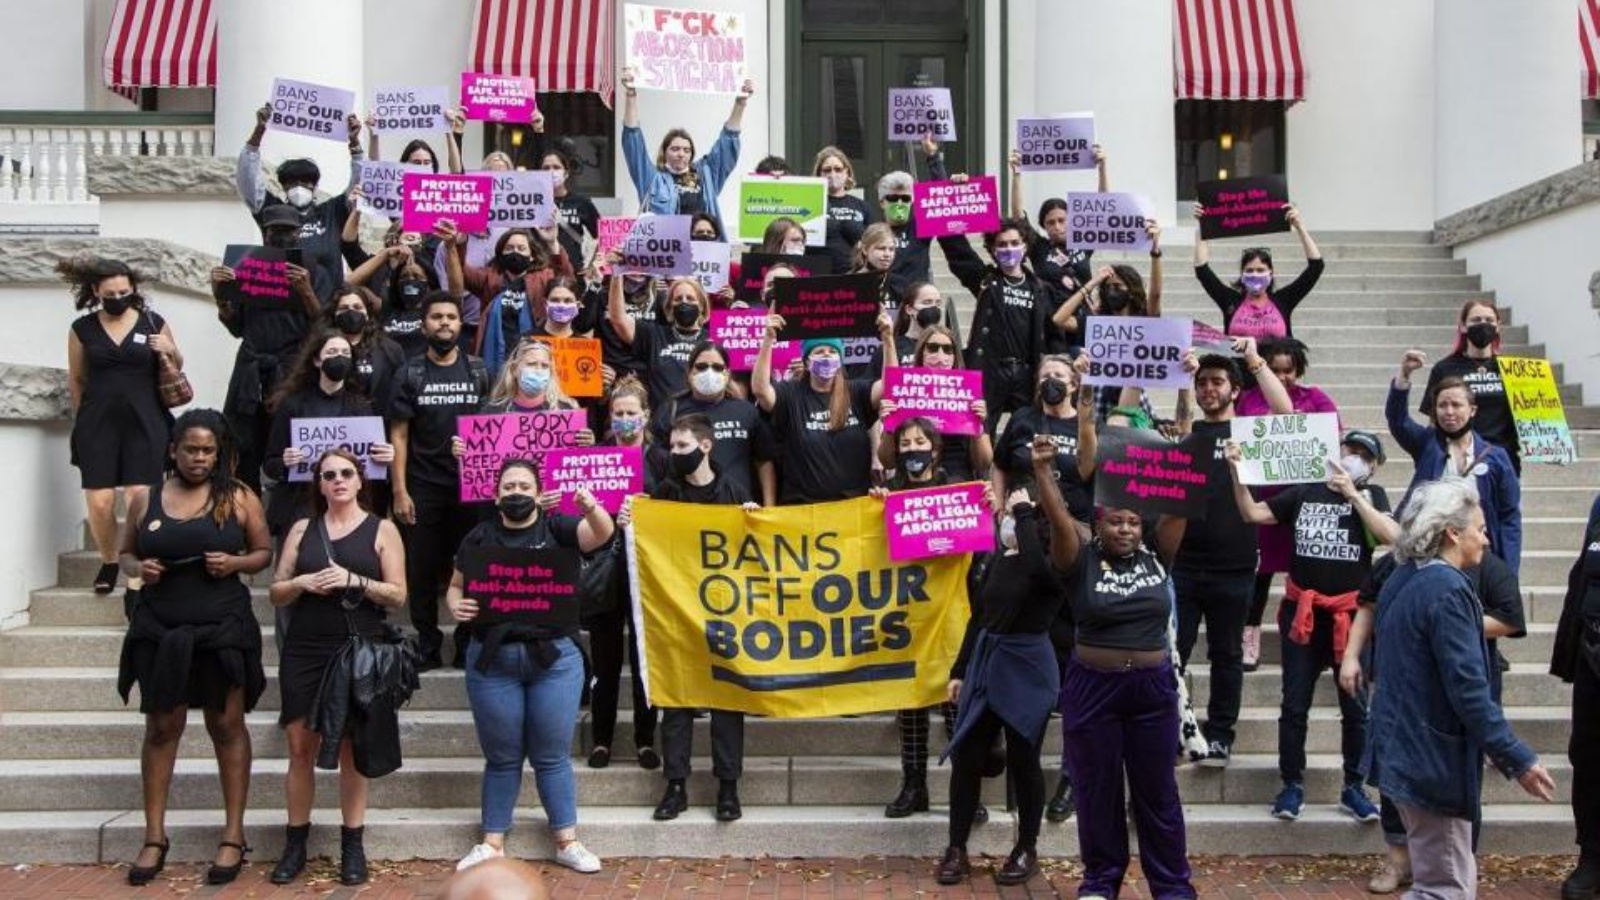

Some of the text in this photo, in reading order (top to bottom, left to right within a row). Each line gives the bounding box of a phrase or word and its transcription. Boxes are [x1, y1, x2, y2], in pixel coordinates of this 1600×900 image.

[632, 31, 744, 63] ABORTION
[641, 59, 737, 91] STIGMA
[476, 77, 521, 88] PROTECT
[277, 85, 318, 102] BANS
[376, 92, 415, 104] BANS
[468, 86, 529, 98] SAFE, LEGAL
[471, 95, 525, 106] ABORTION
[894, 95, 934, 107] BANS
[274, 99, 343, 121] OFF OUR
[376, 105, 440, 116] OFF OUR
[894, 109, 922, 121] OFF
[273, 113, 333, 133] BODIES
[377, 117, 434, 129] BODIES
[894, 123, 949, 135] BODIES
[1022, 125, 1061, 137] BANS
[1021, 138, 1087, 152] OFF OUR
[1021, 152, 1079, 165] BODIES
[364, 167, 403, 181] BANS
[363, 182, 392, 194] OFF
[421, 179, 477, 191] PROTECT
[929, 182, 982, 197] PROTECT
[411, 190, 445, 202] SAFE,
[450, 192, 484, 203] LEGAL
[506, 193, 544, 206] OUR
[920, 193, 991, 209] SAFE, LEGAL
[1217, 188, 1268, 204] Stop the
[415, 203, 479, 214] ABORTION
[926, 204, 987, 219] ABORTION
[1073, 199, 1116, 212] BANS
[1072, 215, 1145, 228] OFF OUR
[1220, 213, 1268, 228] Agenda
[1072, 230, 1136, 244] BODIES
[646, 239, 682, 253] OUR
[241, 282, 289, 298] Agenda
[799, 289, 855, 302] Stop the
[782, 302, 876, 315] Anti-Abortion
[726, 315, 766, 326] PROTE
[801, 317, 854, 329] Agenda
[717, 327, 752, 338] SAFE,
[1092, 324, 1145, 340] BANS
[1090, 343, 1180, 361] OFF OUR
[1089, 363, 1168, 380] BODIES
[1501, 360, 1545, 378] WORSE
[903, 373, 963, 387] PROTECT
[424, 383, 468, 393] ARTICLE
[892, 386, 974, 400] SAFE, LEGAL
[418, 395, 464, 405] SECTION
[897, 398, 969, 412] ABORTION
[1513, 389, 1560, 411] Abortion
[472, 412, 573, 435] MY BODY
[1253, 415, 1307, 438] SAVE
[298, 426, 347, 441] BANS
[466, 435, 500, 452] MY
[462, 454, 500, 469] KEEP
[563, 453, 624, 467] PROTECT
[1126, 445, 1193, 465] Stop the
[552, 465, 634, 481] SAFE, LEGAL
[1103, 460, 1206, 485] Anti-Abortion
[1263, 456, 1327, 480] LIVES
[559, 479, 629, 493] ABORTION
[1126, 479, 1186, 499] Agenda
[903, 491, 969, 510] PROTECT
[894, 503, 982, 525] SAFE, LEGAL
[1301, 503, 1351, 515] STAND
[900, 517, 978, 537] ABORTION
[1298, 516, 1338, 528] WITH
[1296, 529, 1349, 543] BLACK
[700, 530, 842, 572] BANS
[1296, 543, 1361, 560] WOMEN
[488, 564, 553, 580] Stop the
[467, 579, 574, 595] Anti-Abortion
[699, 564, 931, 616] OFF OUR
[490, 597, 550, 612] Agenda
[705, 611, 913, 662] BODIES
